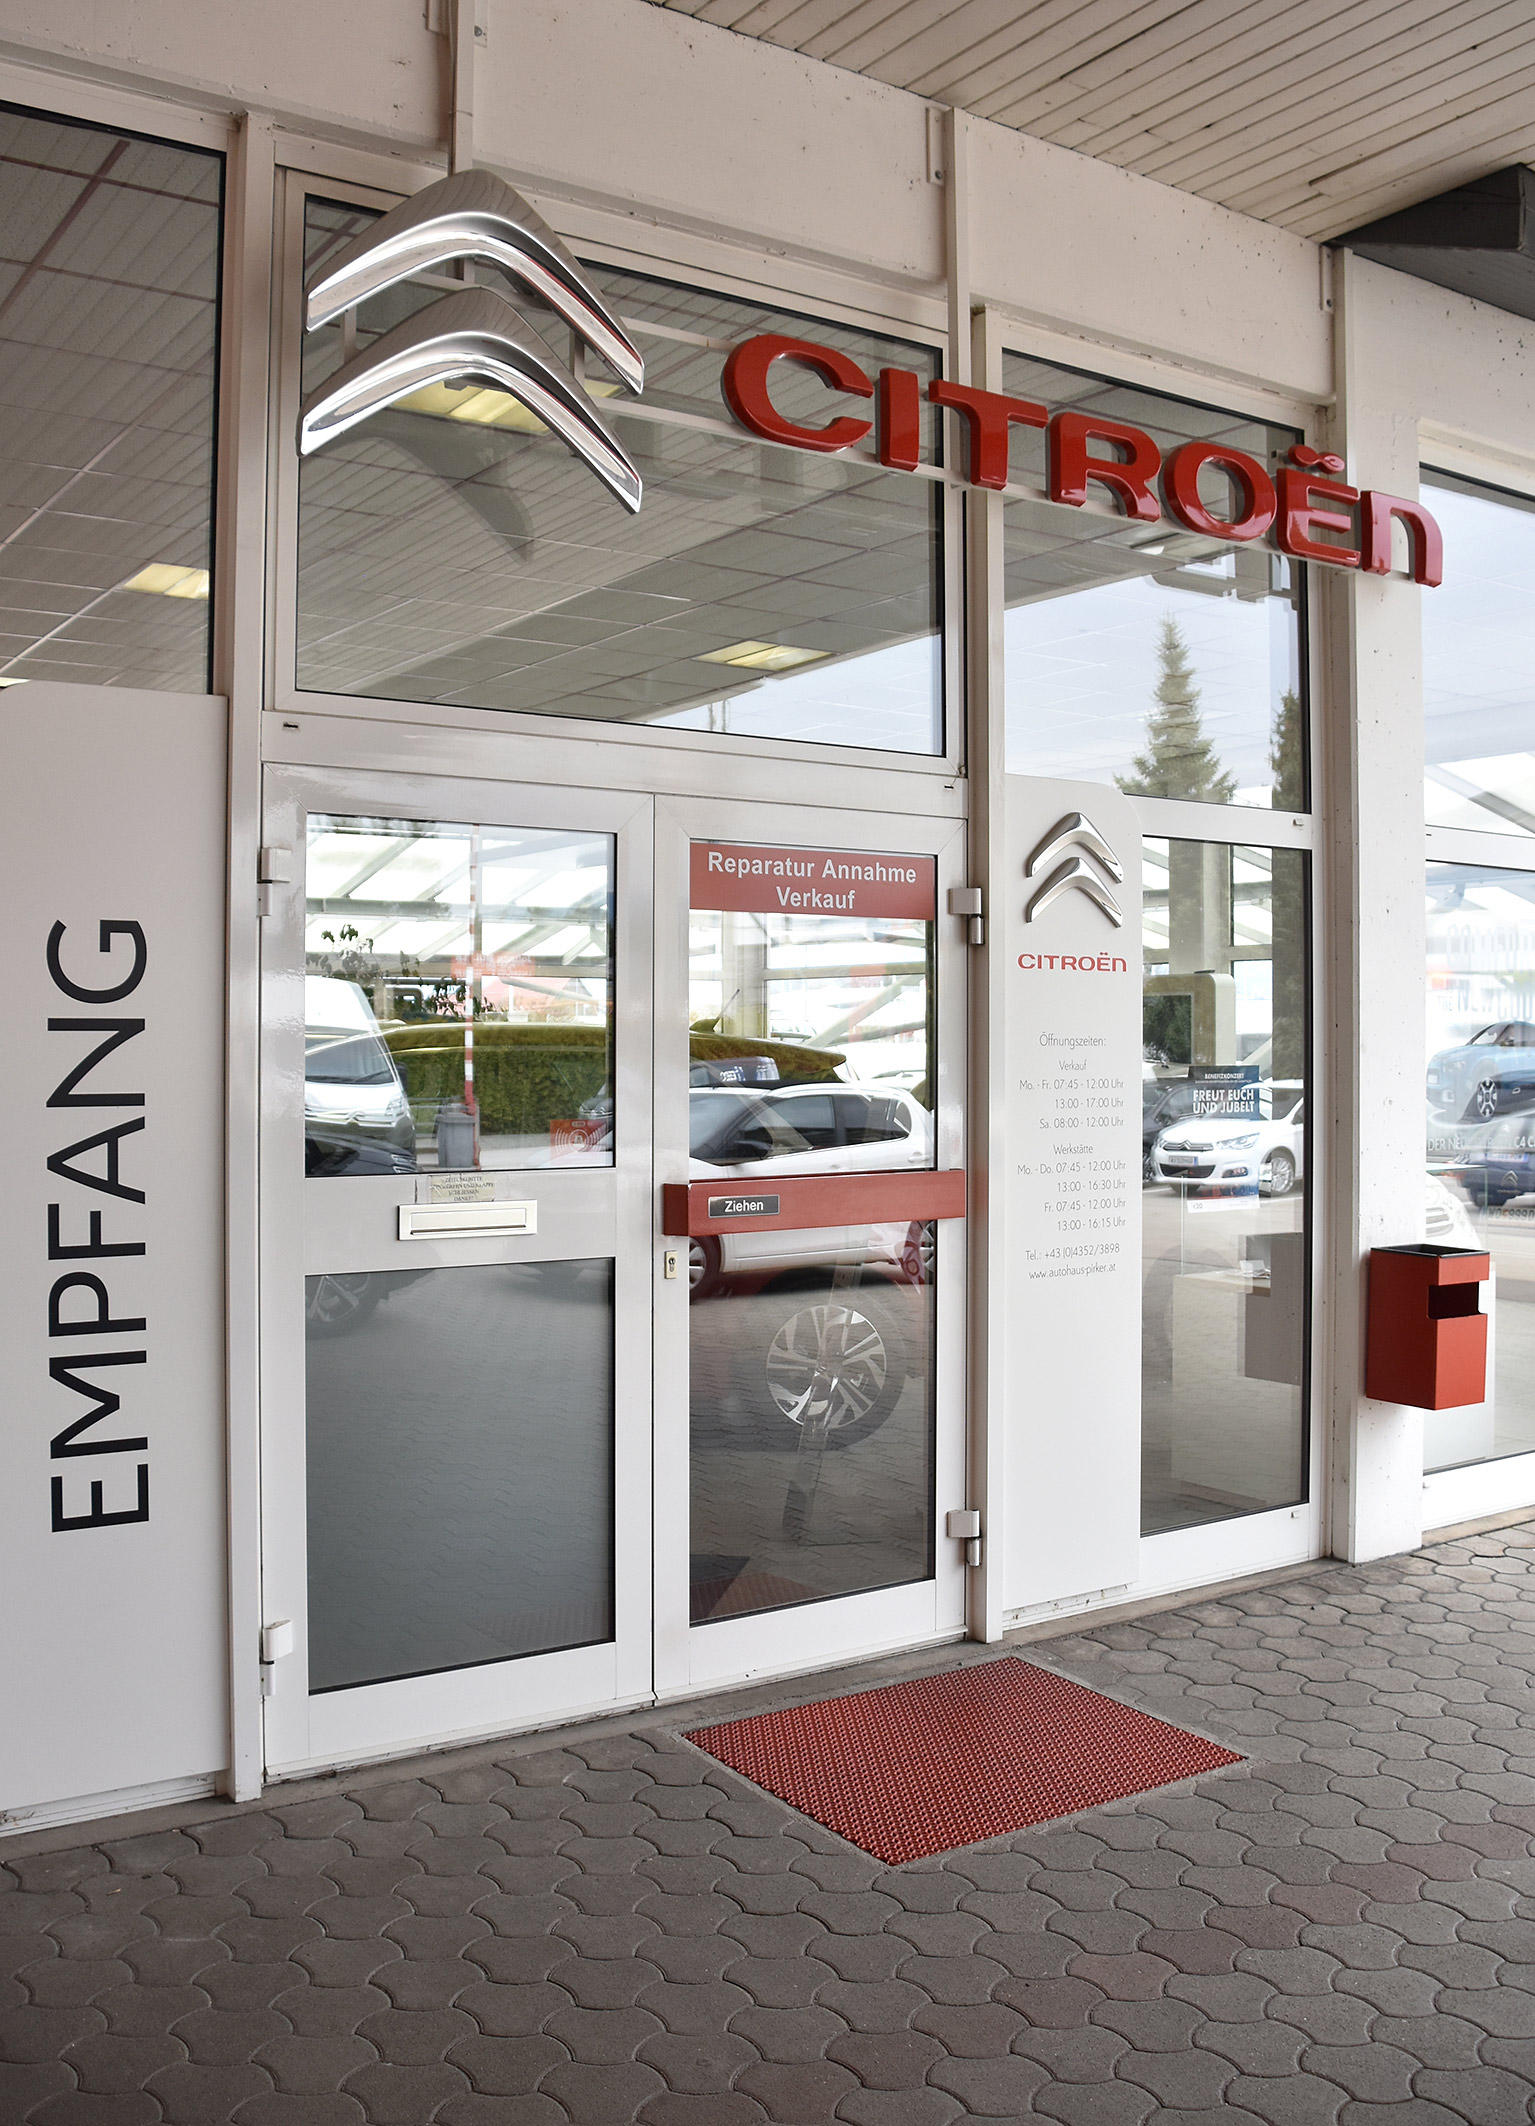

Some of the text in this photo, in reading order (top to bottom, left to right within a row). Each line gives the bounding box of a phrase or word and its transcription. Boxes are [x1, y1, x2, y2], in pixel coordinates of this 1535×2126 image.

[708, 851, 917, 884] Reparatur Annahme
[775, 886, 856, 910] Verkauf
[1039, 1032, 1106, 1049] Öffnungszeiten:
[1059, 1059, 1087, 1071] Verkauf
[1041, 1080, 1052, 1090] Fr.
[1111, 1078, 1124, 1089] Uhr
[1193, 1089, 1254, 1101] FREUT EUCH
[1111, 1097, 1124, 1108] Uhr
[1193, 1101, 1255, 1114] UND JUBELT
[1039, 1118, 1052, 1129] Sa.
[1111, 1116, 1124, 1127] Uhr
[1053, 1144, 1093, 1155] Werkstätte
[1017, 1164, 1033, 1175] Mo.
[1040, 1163, 1054, 1174] Do.
[1113, 1160, 1126, 1170] Uhr
[1113, 1179, 1126, 1189] Uhr
[724, 1200, 764, 1212] Ziehen
[1044, 1202, 1054, 1213] Fr.
[1113, 1198, 1126, 1208] Uhr
[46, 919, 150, 1533] EMPFANG
[1113, 1216, 1126, 1227] Uhr
[1045, 1248, 1061, 1259] +43
